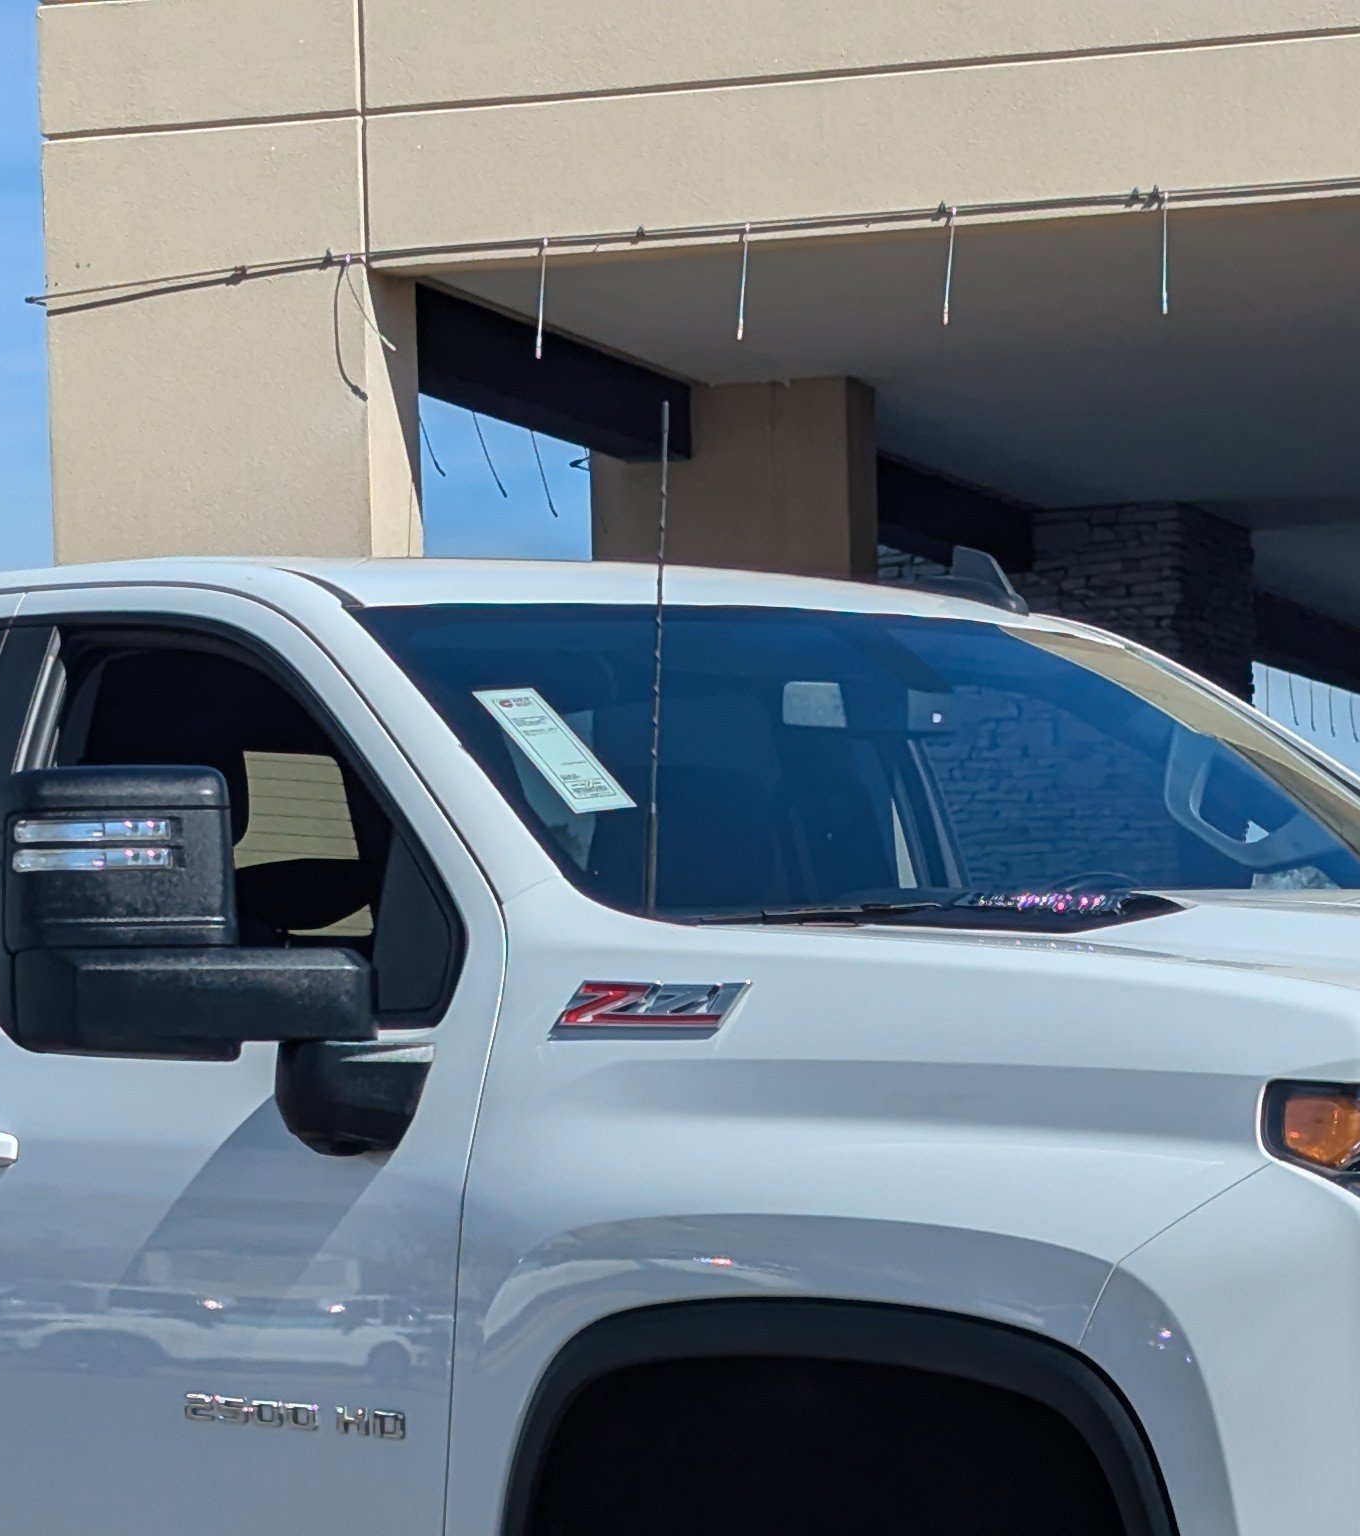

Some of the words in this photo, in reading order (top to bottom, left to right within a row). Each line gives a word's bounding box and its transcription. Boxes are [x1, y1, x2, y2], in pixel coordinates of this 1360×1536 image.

[550, 980, 751, 1036] Z71
[184, 1391, 319, 1432] 2500
[335, 1404, 407, 1440] HD
